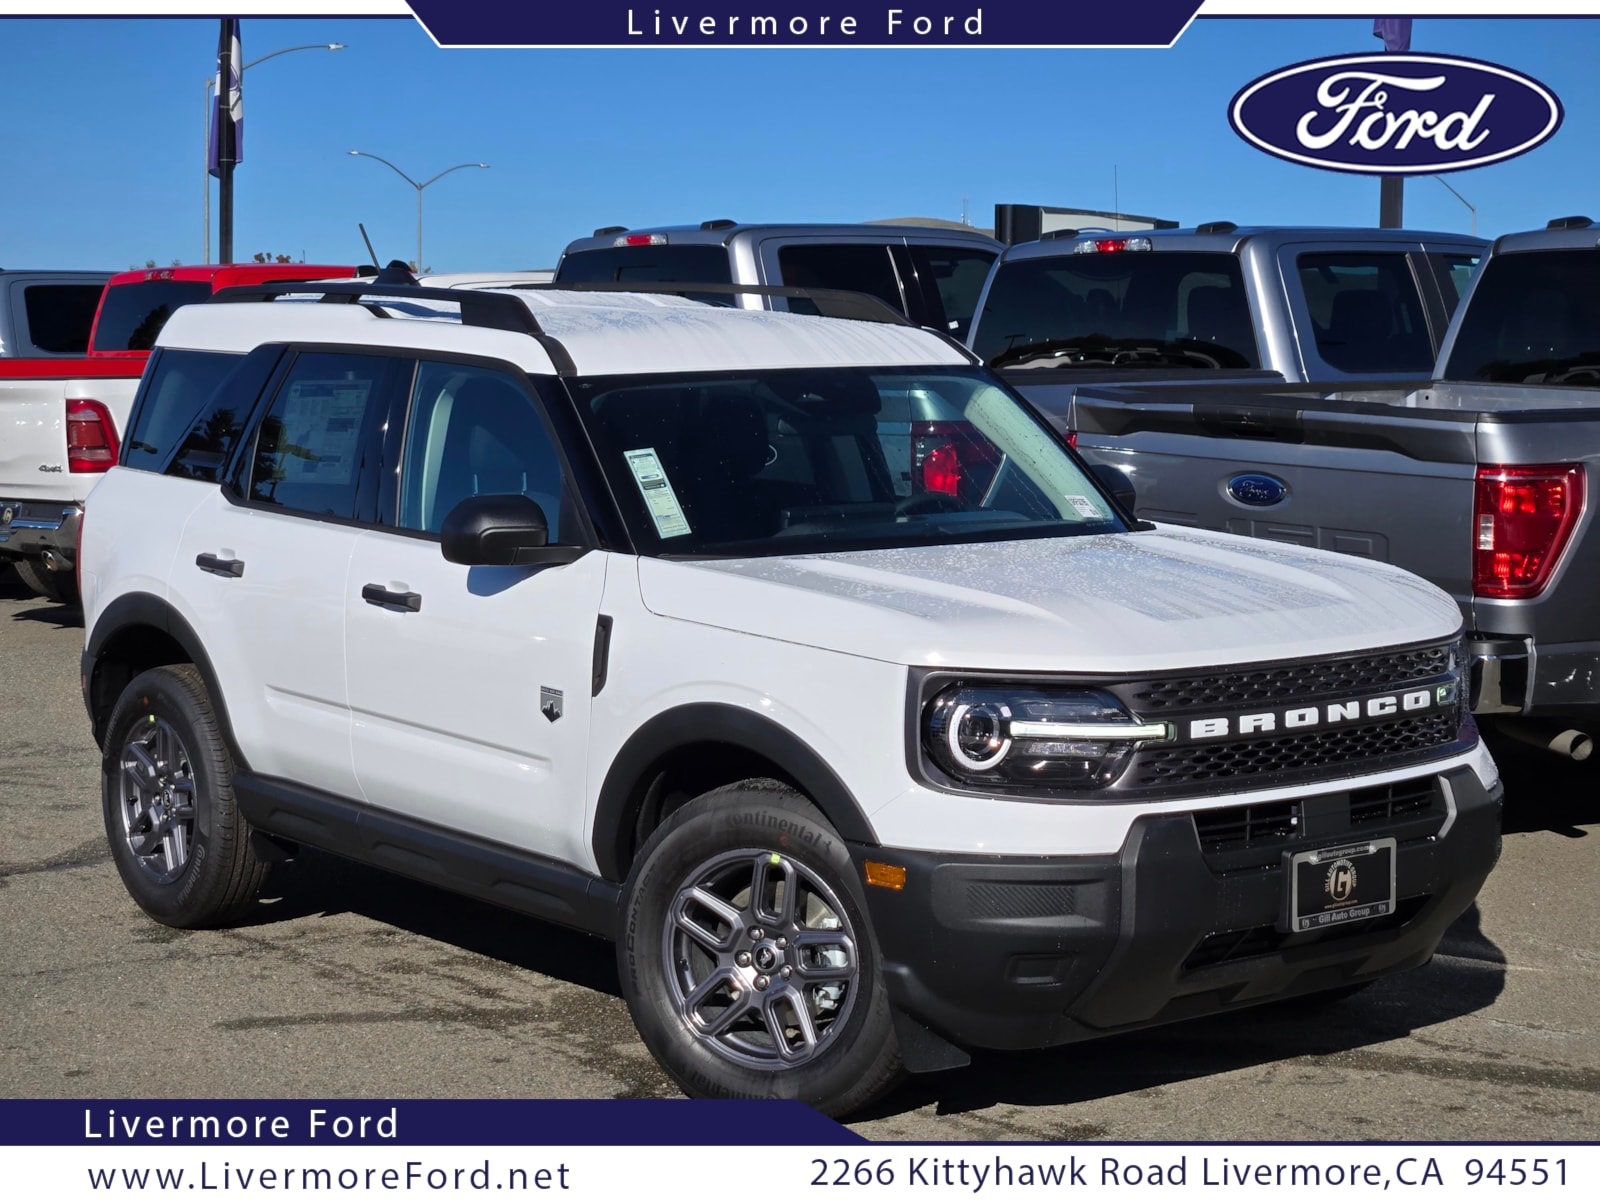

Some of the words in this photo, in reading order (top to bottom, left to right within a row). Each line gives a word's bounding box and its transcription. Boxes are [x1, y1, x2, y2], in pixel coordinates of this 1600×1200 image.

[1190, 690, 1431, 739] BRONCO
[1318, 914, 1331, 923] Gill
[1331, 911, 1348, 921] Auto
[1349, 907, 1370, 918] Group
